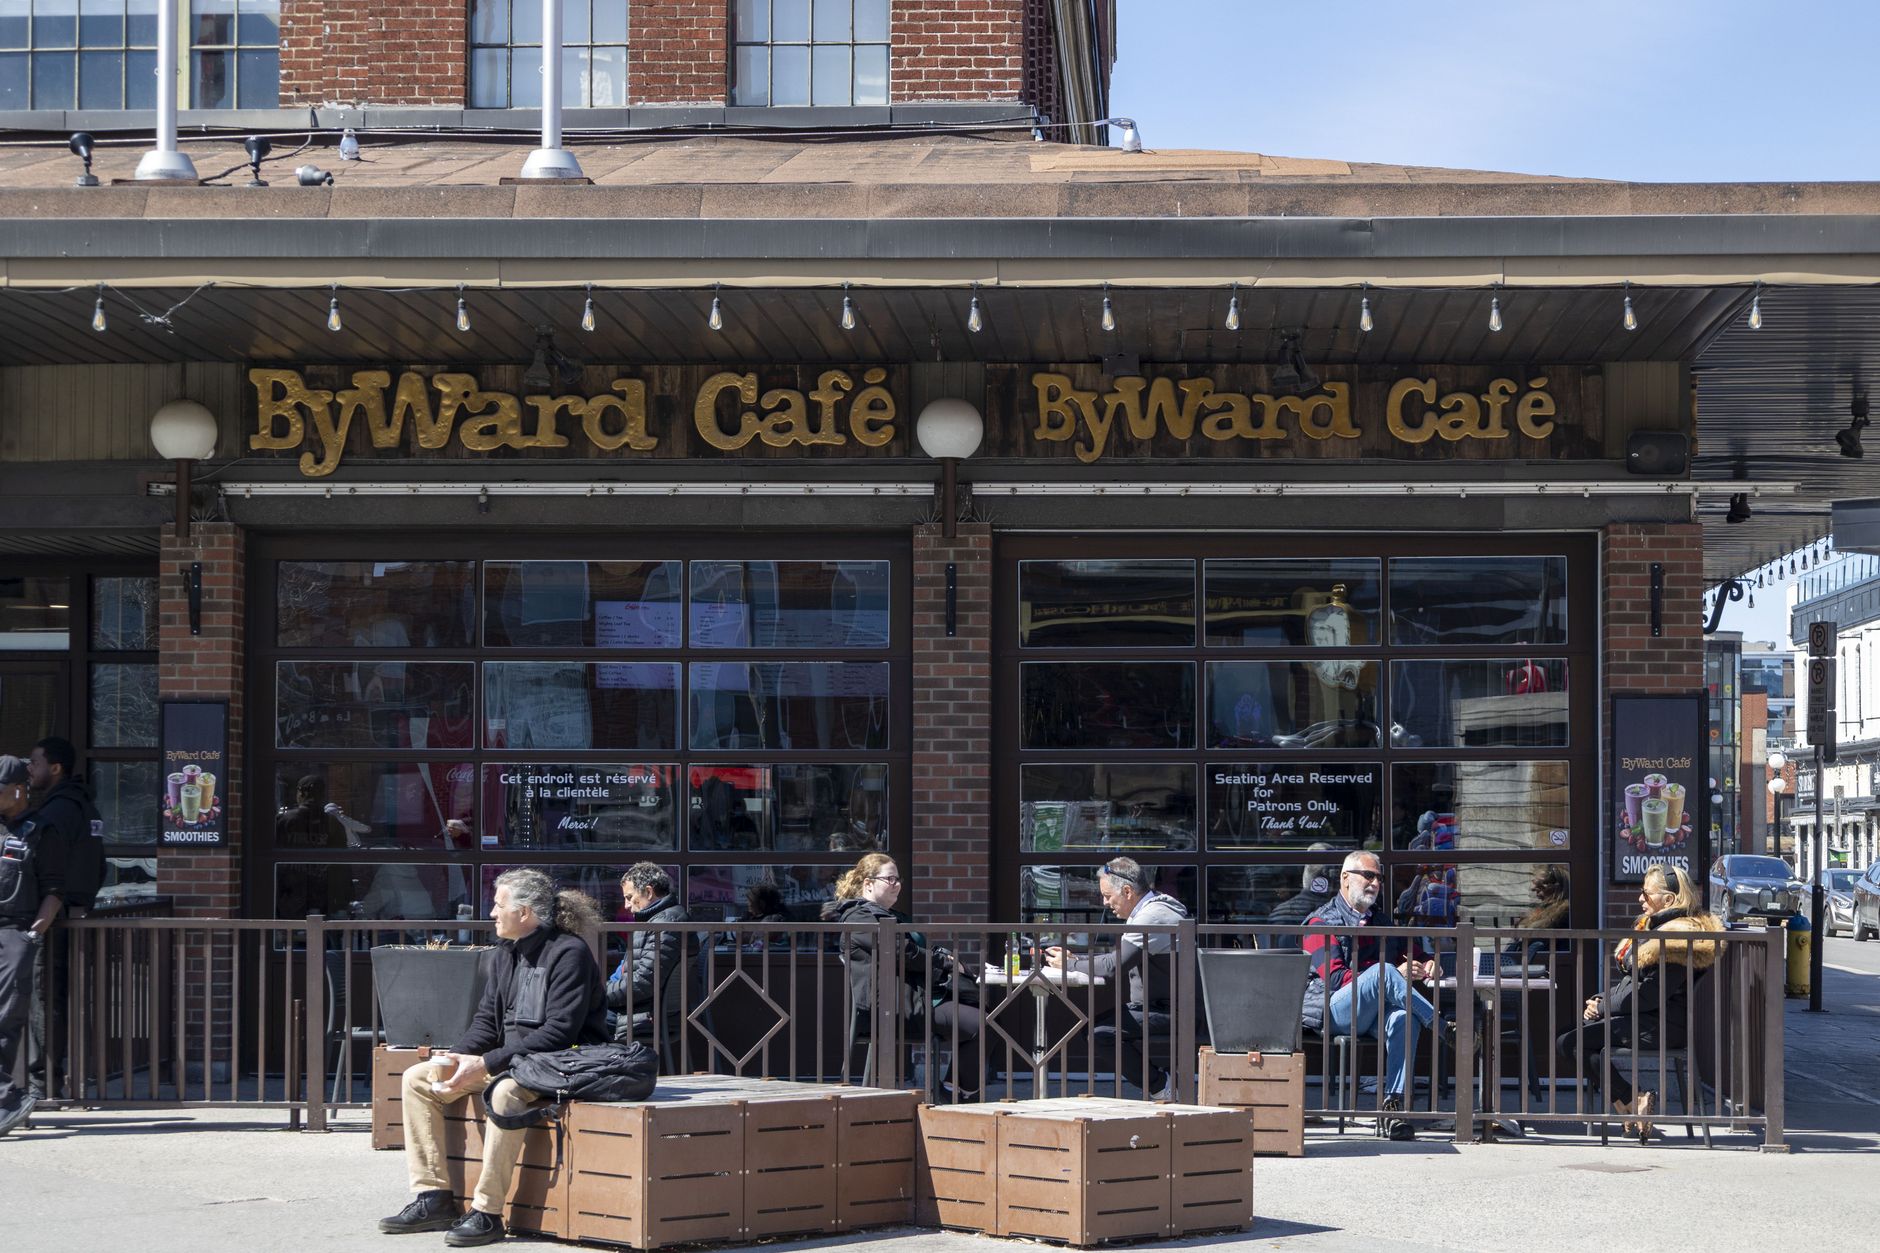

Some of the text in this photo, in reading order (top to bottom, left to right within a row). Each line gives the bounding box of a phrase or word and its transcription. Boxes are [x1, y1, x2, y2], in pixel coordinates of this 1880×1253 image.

[248, 366, 896, 477] ByWard Café
[1032, 372, 1556, 463] ByWard Café
[167, 750, 221, 761] ByWard Café
[1621, 757, 1691, 771] ByWard Café
[500, 773, 656, 784] Cet endroit est réservé
[1215, 772, 1373, 786] Seating Area Reserved
[539, 787, 551, 798] la
[556, 787, 609, 798] clientèle
[1253, 787, 1274, 798] for
[1247, 800, 1340, 813] Patrons Only.
[1260, 815, 1327, 830] Thank You!
[164, 831, 220, 842] SMOOTHIES
